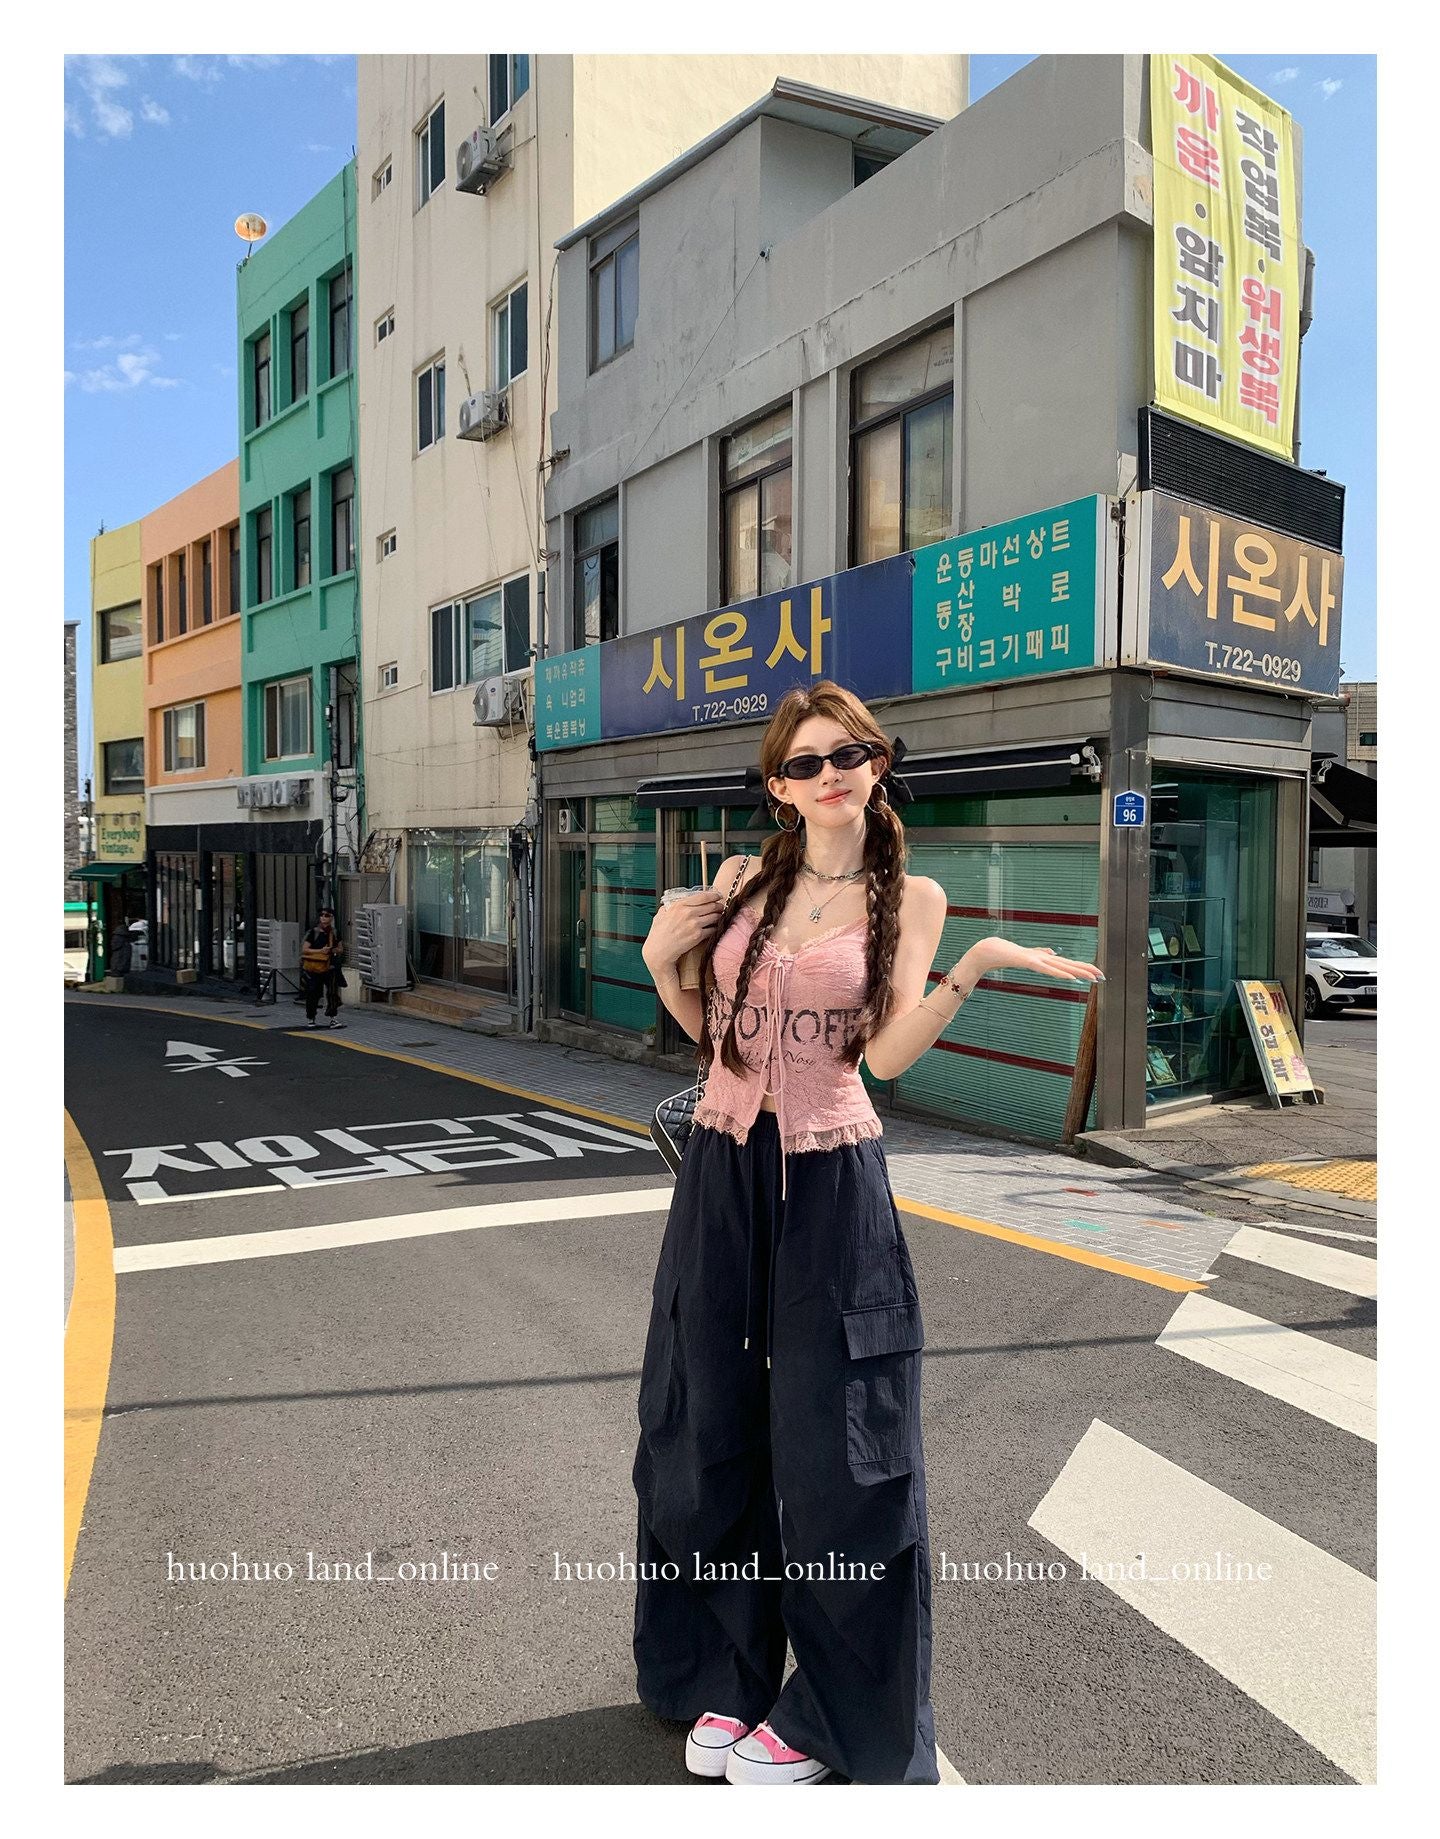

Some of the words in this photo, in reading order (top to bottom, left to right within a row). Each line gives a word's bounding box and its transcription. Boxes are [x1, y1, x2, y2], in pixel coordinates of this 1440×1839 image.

[1161, 515, 1336, 647] 시온사
[642, 586, 832, 701] 시온사
[1205, 641, 1301, 683] T.722-0929
[692, 693, 768, 723] T.722-0929
[1123, 808, 1137, 822] 96
[102, 1110, 658, 1206] 진입금지
